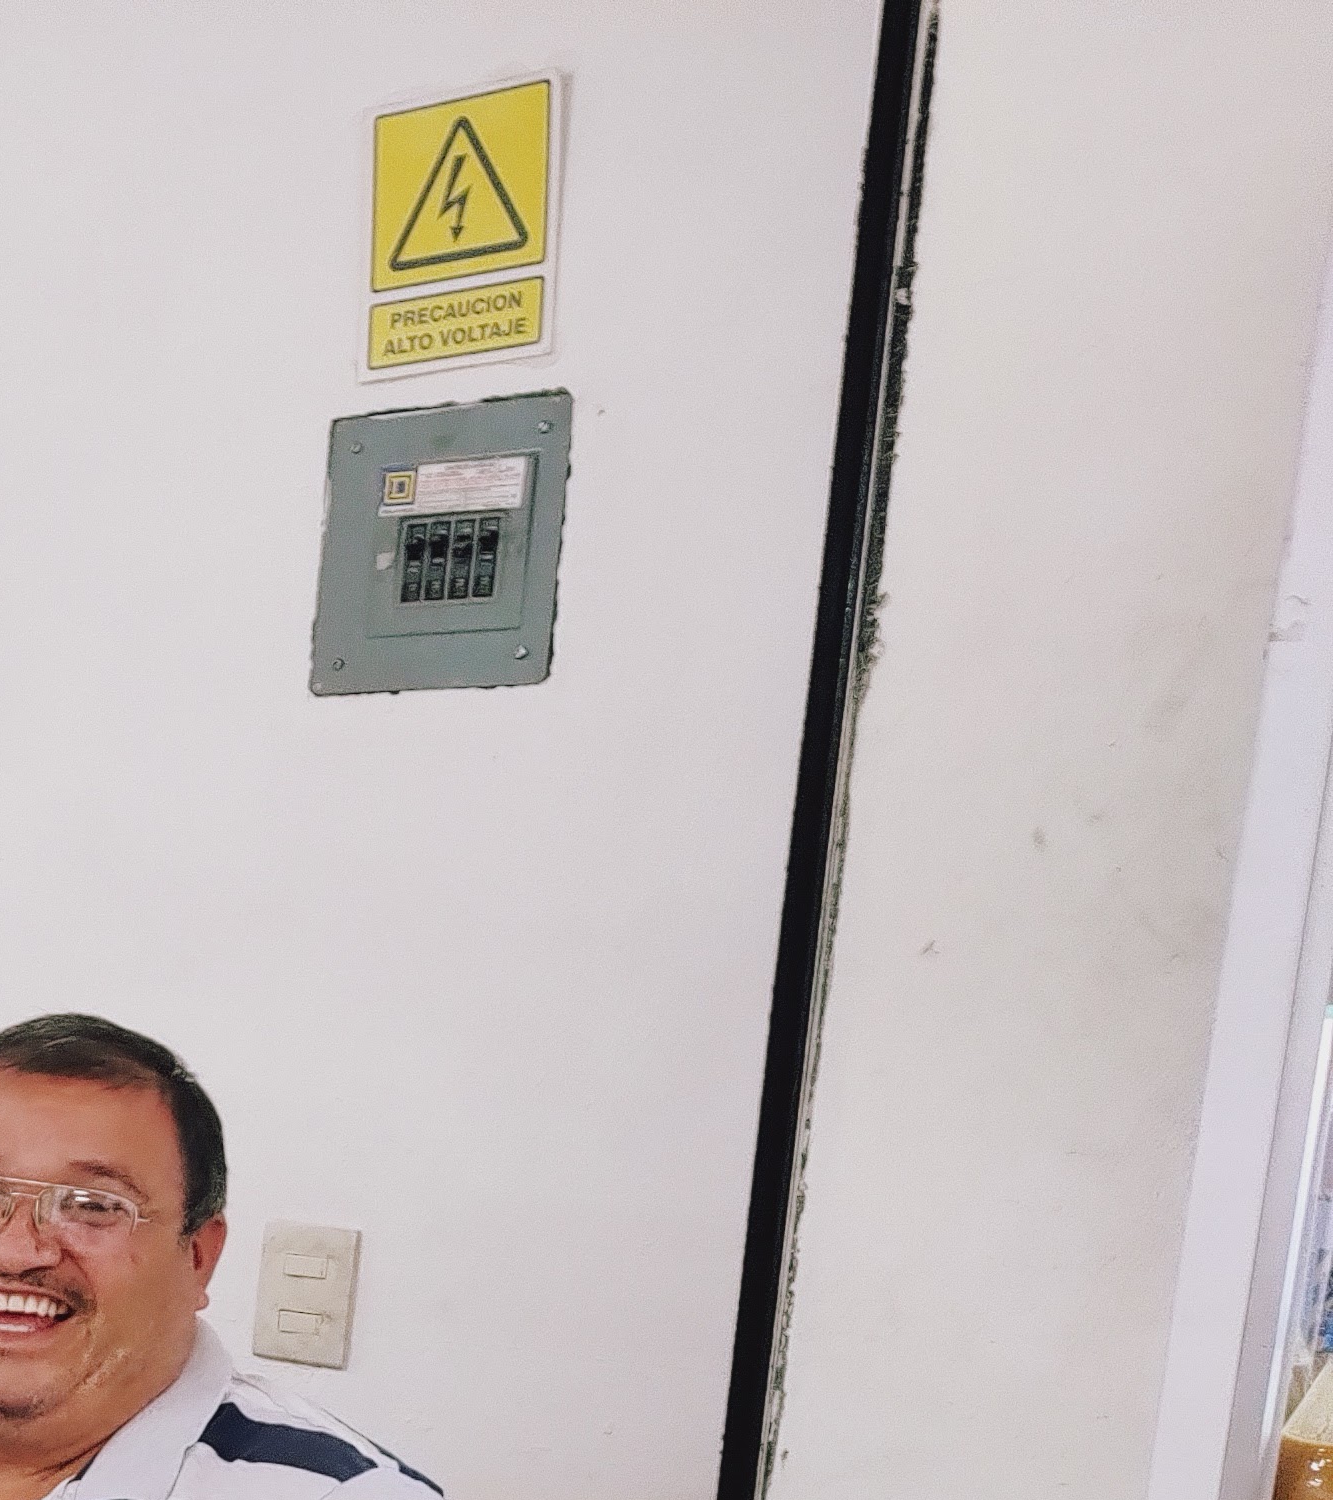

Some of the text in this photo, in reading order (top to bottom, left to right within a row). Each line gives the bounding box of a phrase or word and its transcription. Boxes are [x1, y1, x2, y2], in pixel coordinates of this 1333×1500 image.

[389, 290, 523, 330] PRECAUCION
[383, 317, 527, 356] ALTO VOLTAJE
